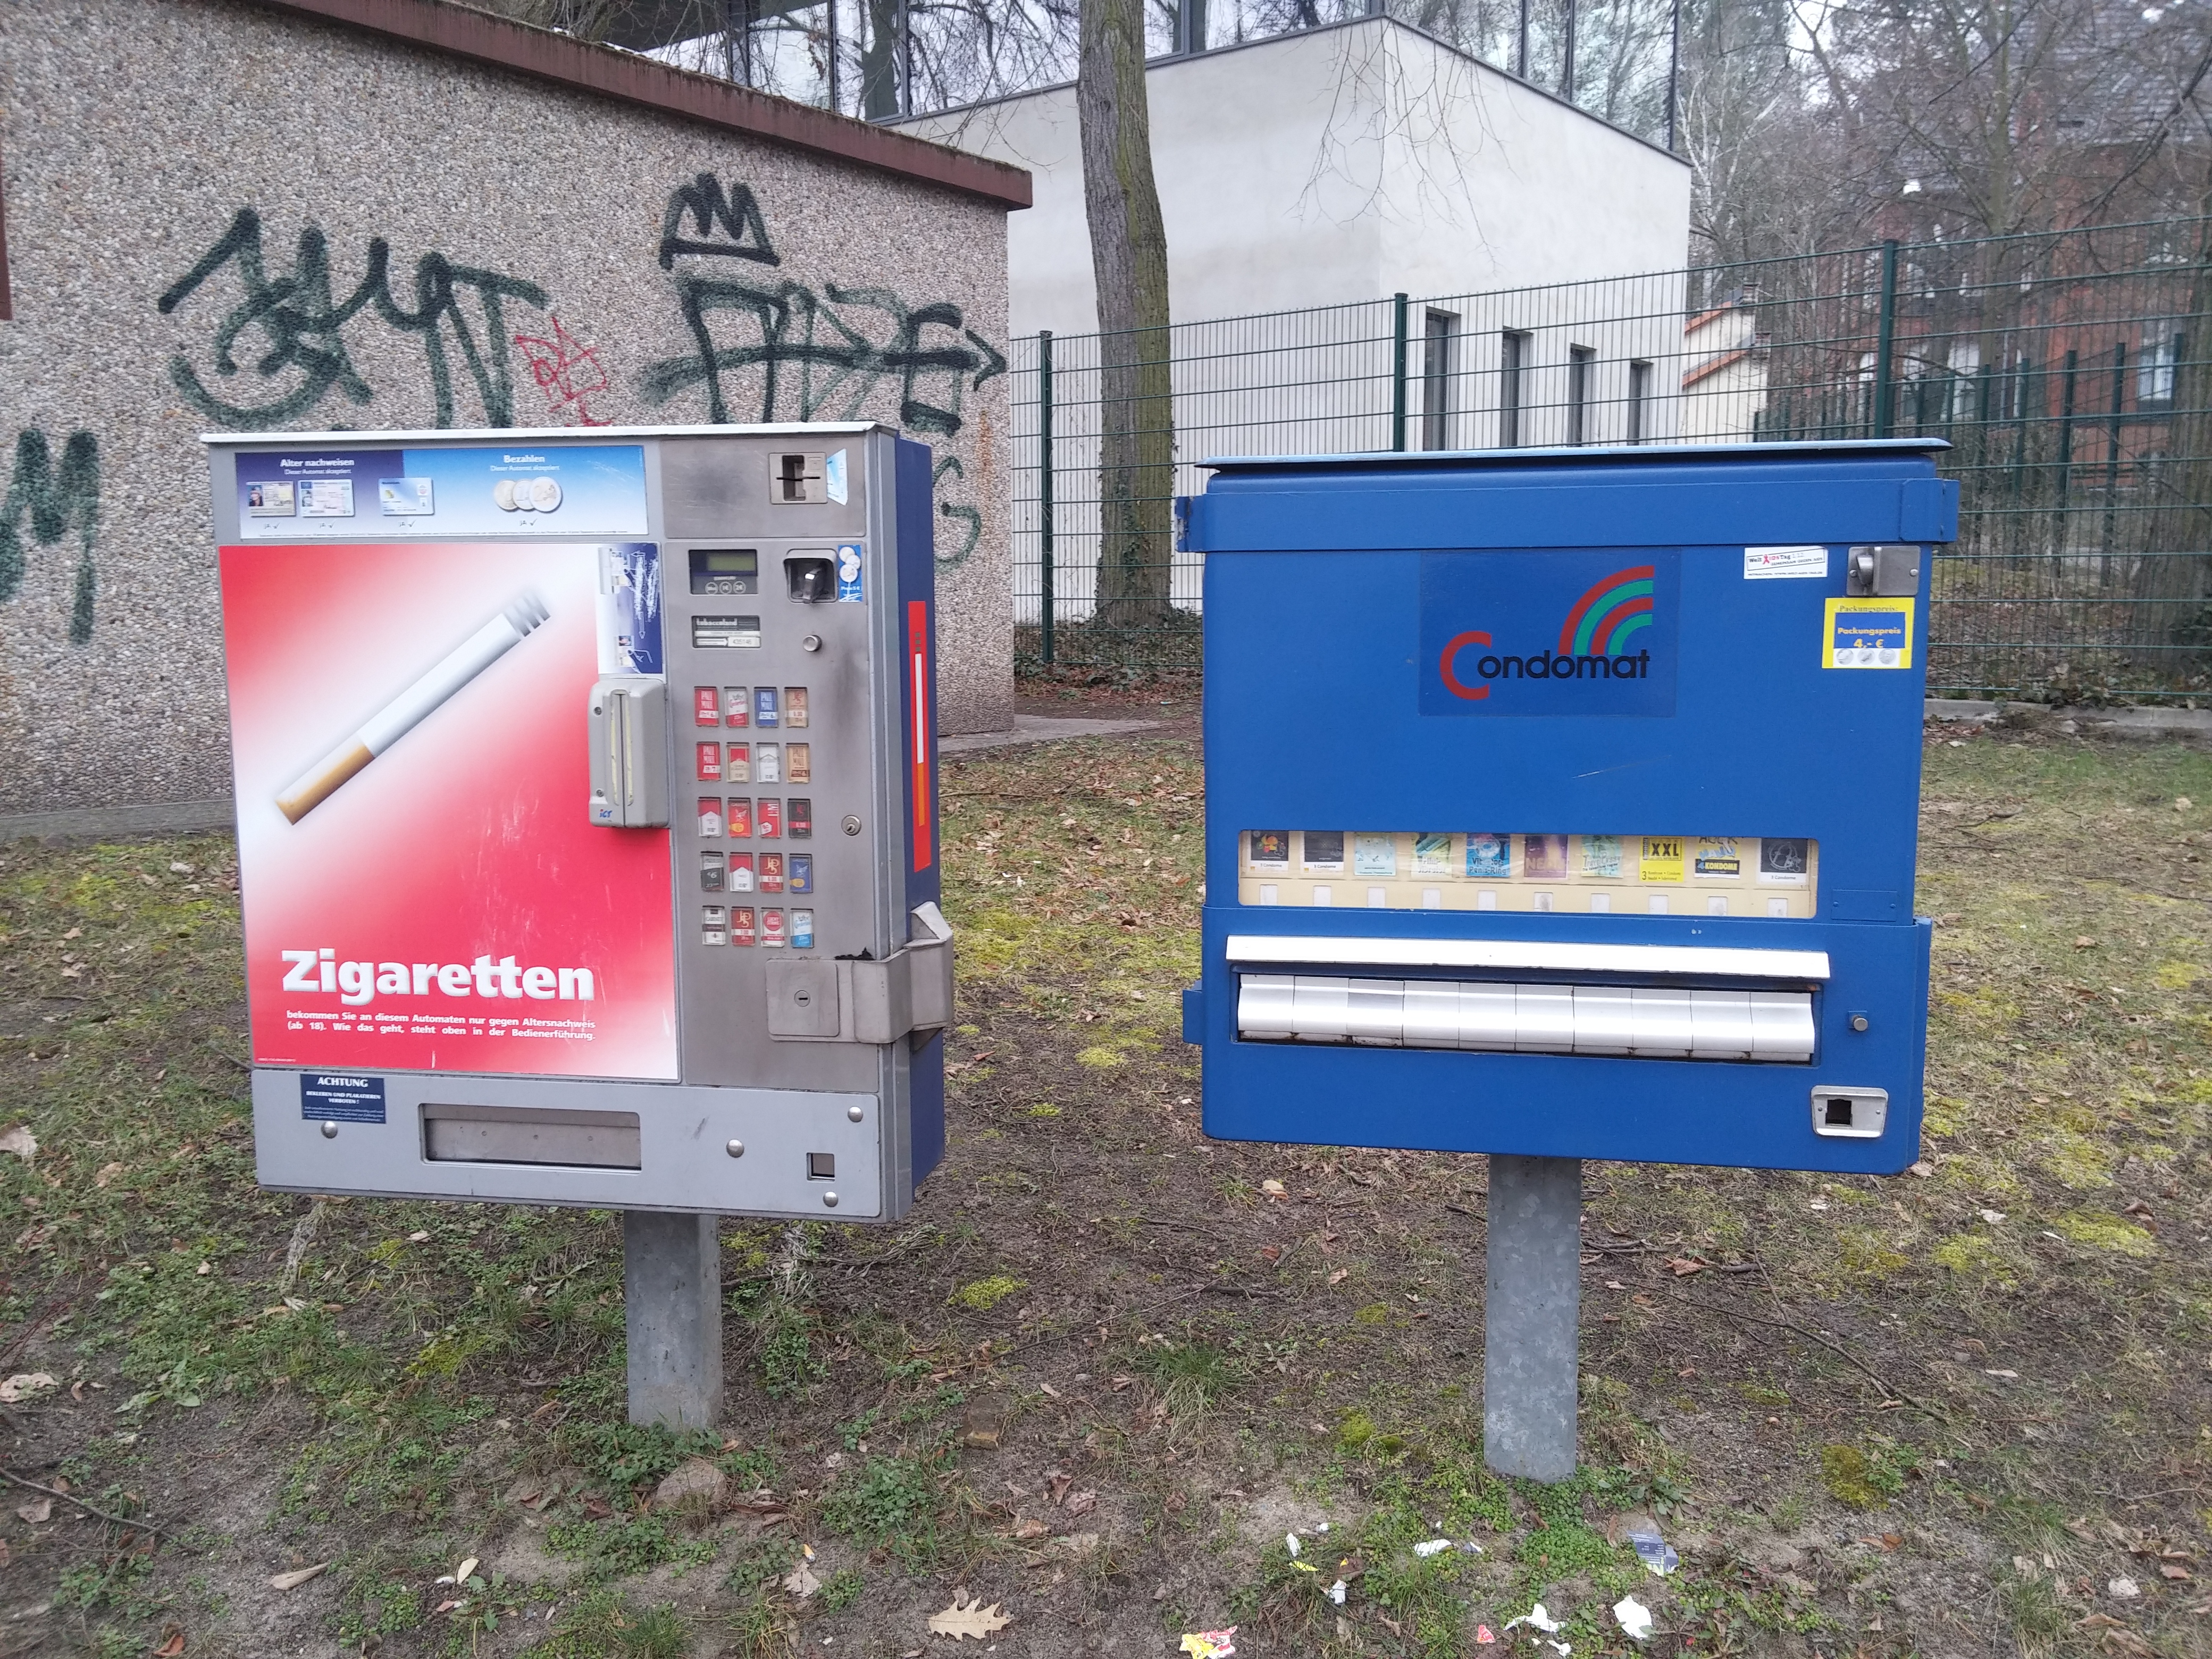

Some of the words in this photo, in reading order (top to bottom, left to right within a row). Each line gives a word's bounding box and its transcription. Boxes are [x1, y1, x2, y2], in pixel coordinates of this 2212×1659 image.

[280, 458, 304, 467] Alter
[305, 458, 355, 466] nachweisen
[1837, 627, 1901, 635] Packungspreis
[1875, 639, 1884, 648] €
[1440, 631, 1650, 700] Condomat
[1652, 843, 1679, 857] XXL
[1705, 862, 1738, 871] KONDOME
[1642, 871, 1647, 880] 3
[281, 948, 595, 1006] Zigaretten
[287, 1010, 339, 1020] bekommen
[375, 1012, 409, 1022] diesem
[412, 1014, 465, 1024] Automaten
[489, 1018, 519, 1027] gegen
[522, 1018, 596, 1028] Altersnachweis
[287, 1021, 303, 1030] (ab
[309, 1021, 327, 1032] 18).
[332, 1022, 351, 1030] Wie
[357, 1023, 374, 1032] das
[380, 1024, 405, 1034] geht,
[410, 1025, 437, 1034] steht
[442, 1026, 467, 1035] oben
[473, 1027, 483, 1035] in
[489, 1027, 506, 1036] der
[512, 1028, 596, 1041] Bedienerführung.
[317, 1077, 369, 1087] ACHTUNG
